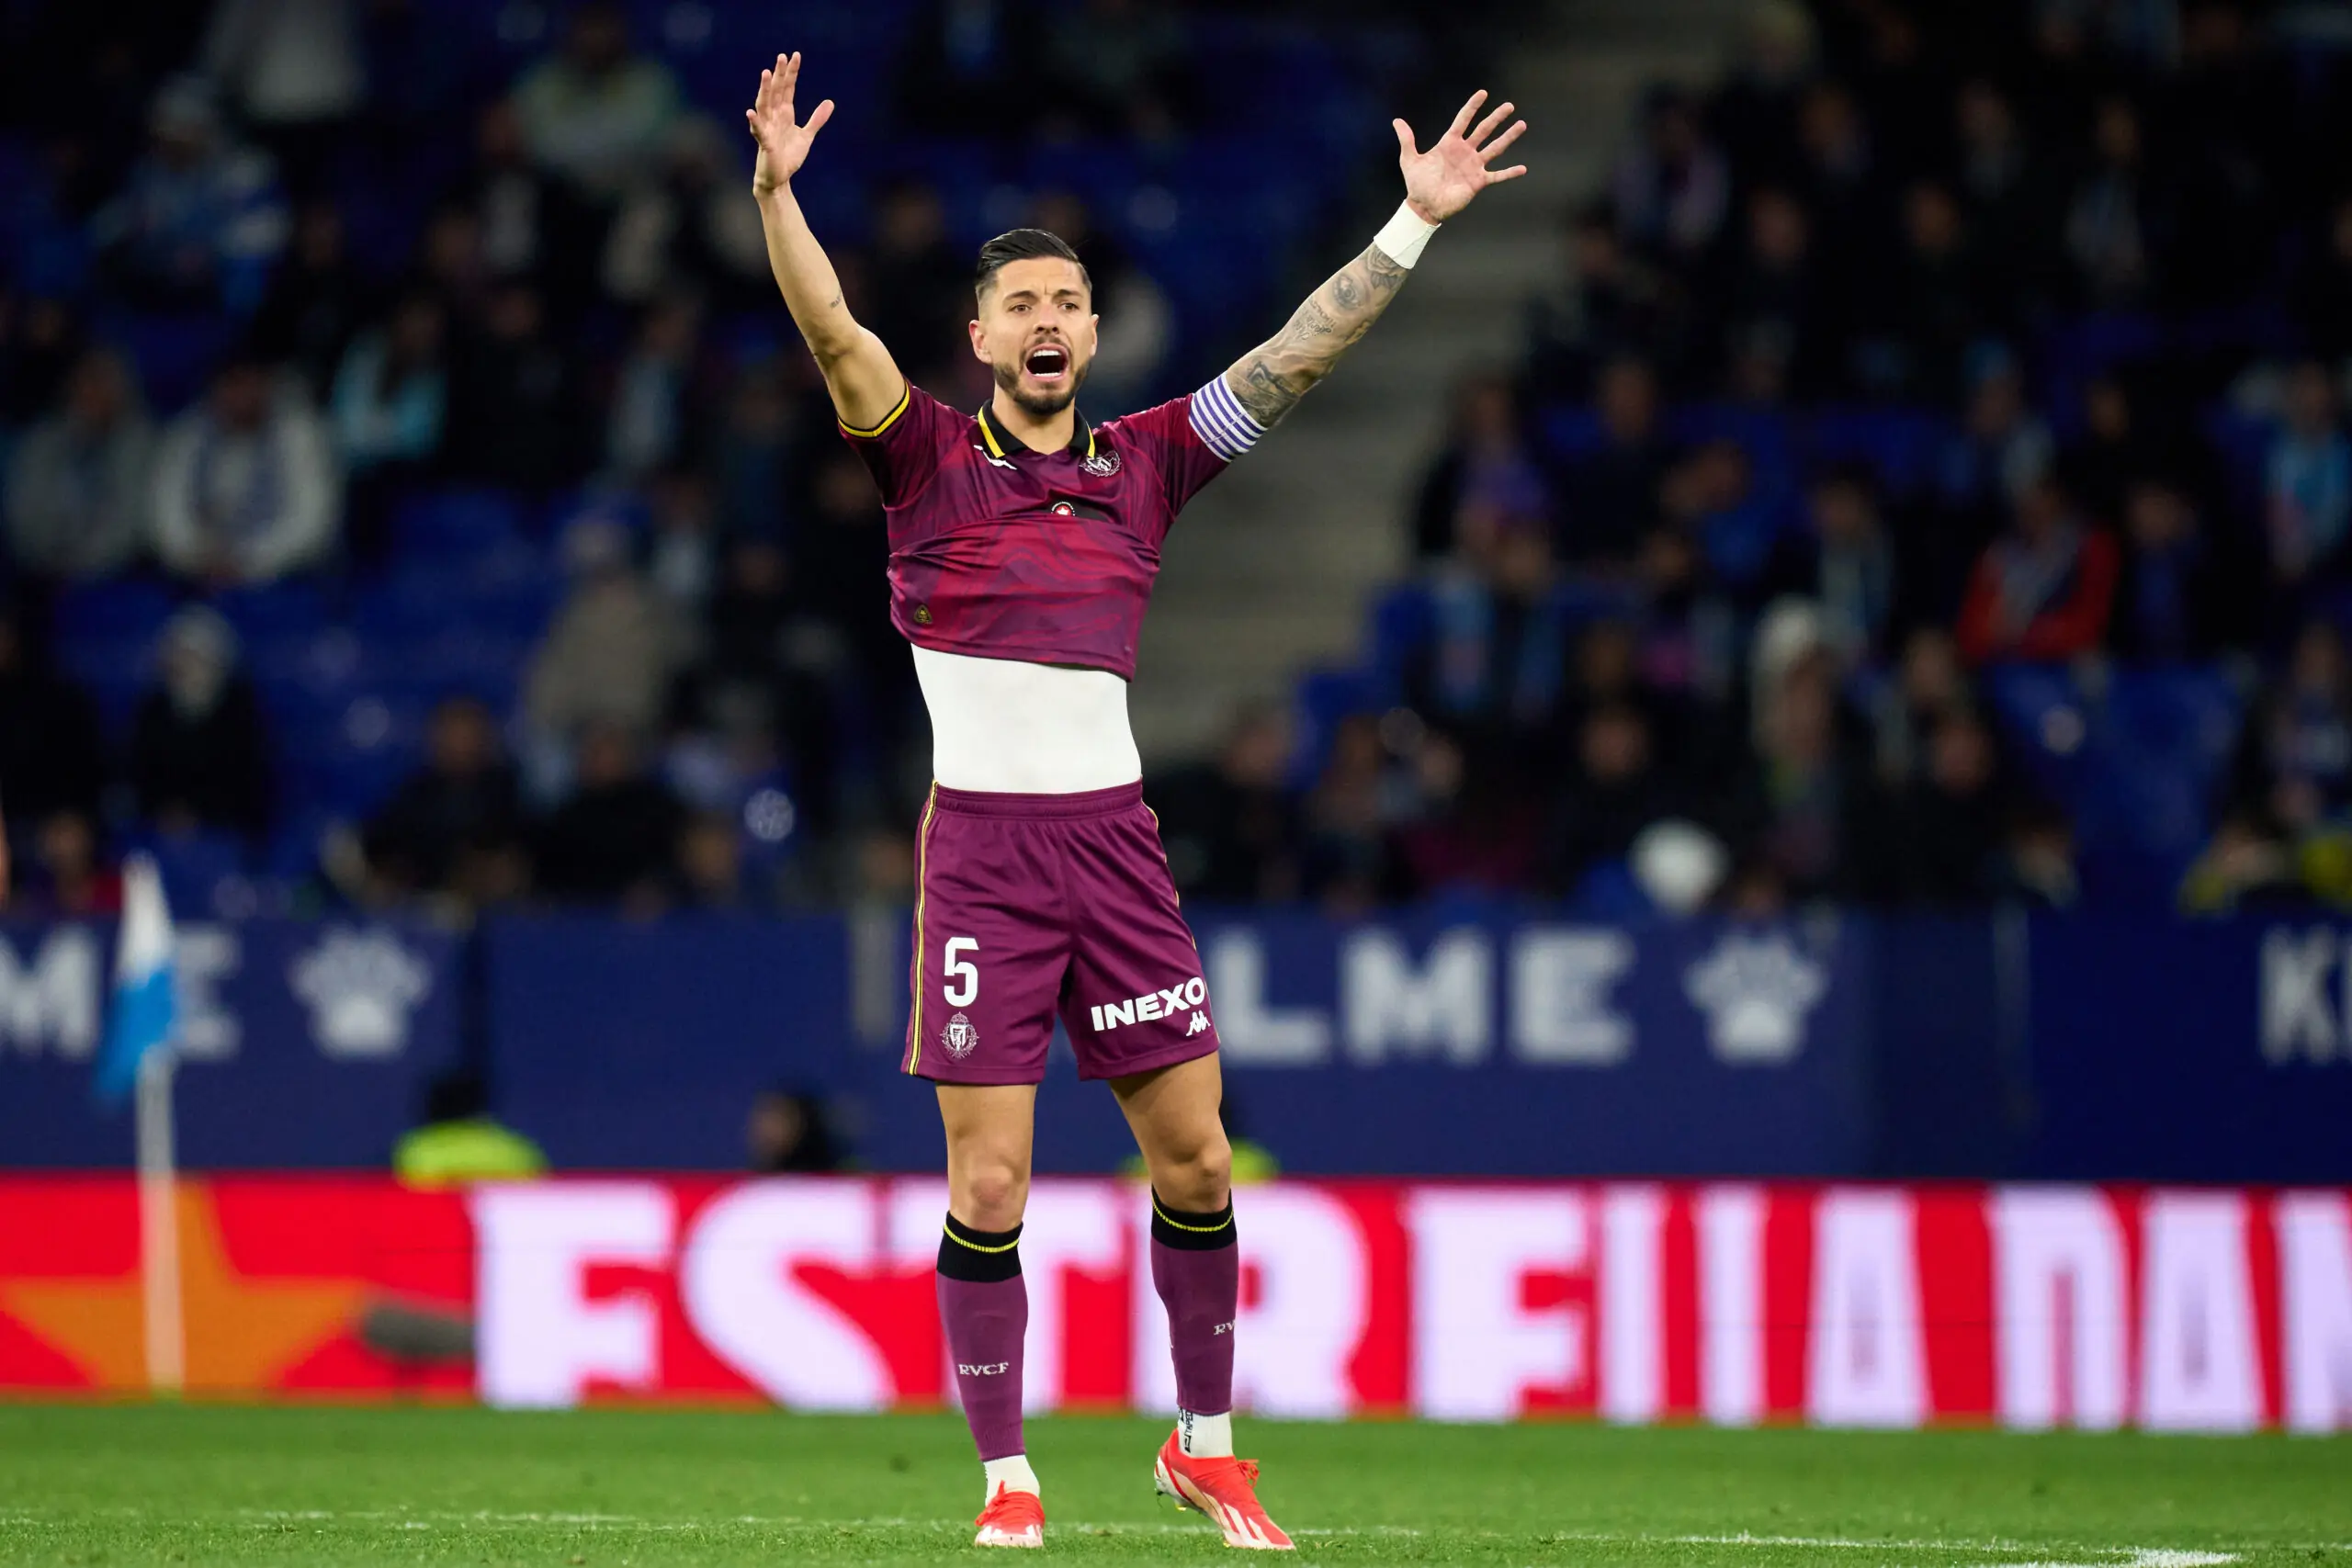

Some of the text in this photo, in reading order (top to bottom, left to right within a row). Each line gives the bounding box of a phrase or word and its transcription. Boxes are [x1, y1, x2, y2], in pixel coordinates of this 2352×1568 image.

[944, 936, 979, 1008] 5
[1091, 976, 1205, 1032] INEXO
[1207, 925, 1638, 1066] LME
[2258, 923, 2352, 1066] K
[958, 1361, 1009, 1377] RVCF
